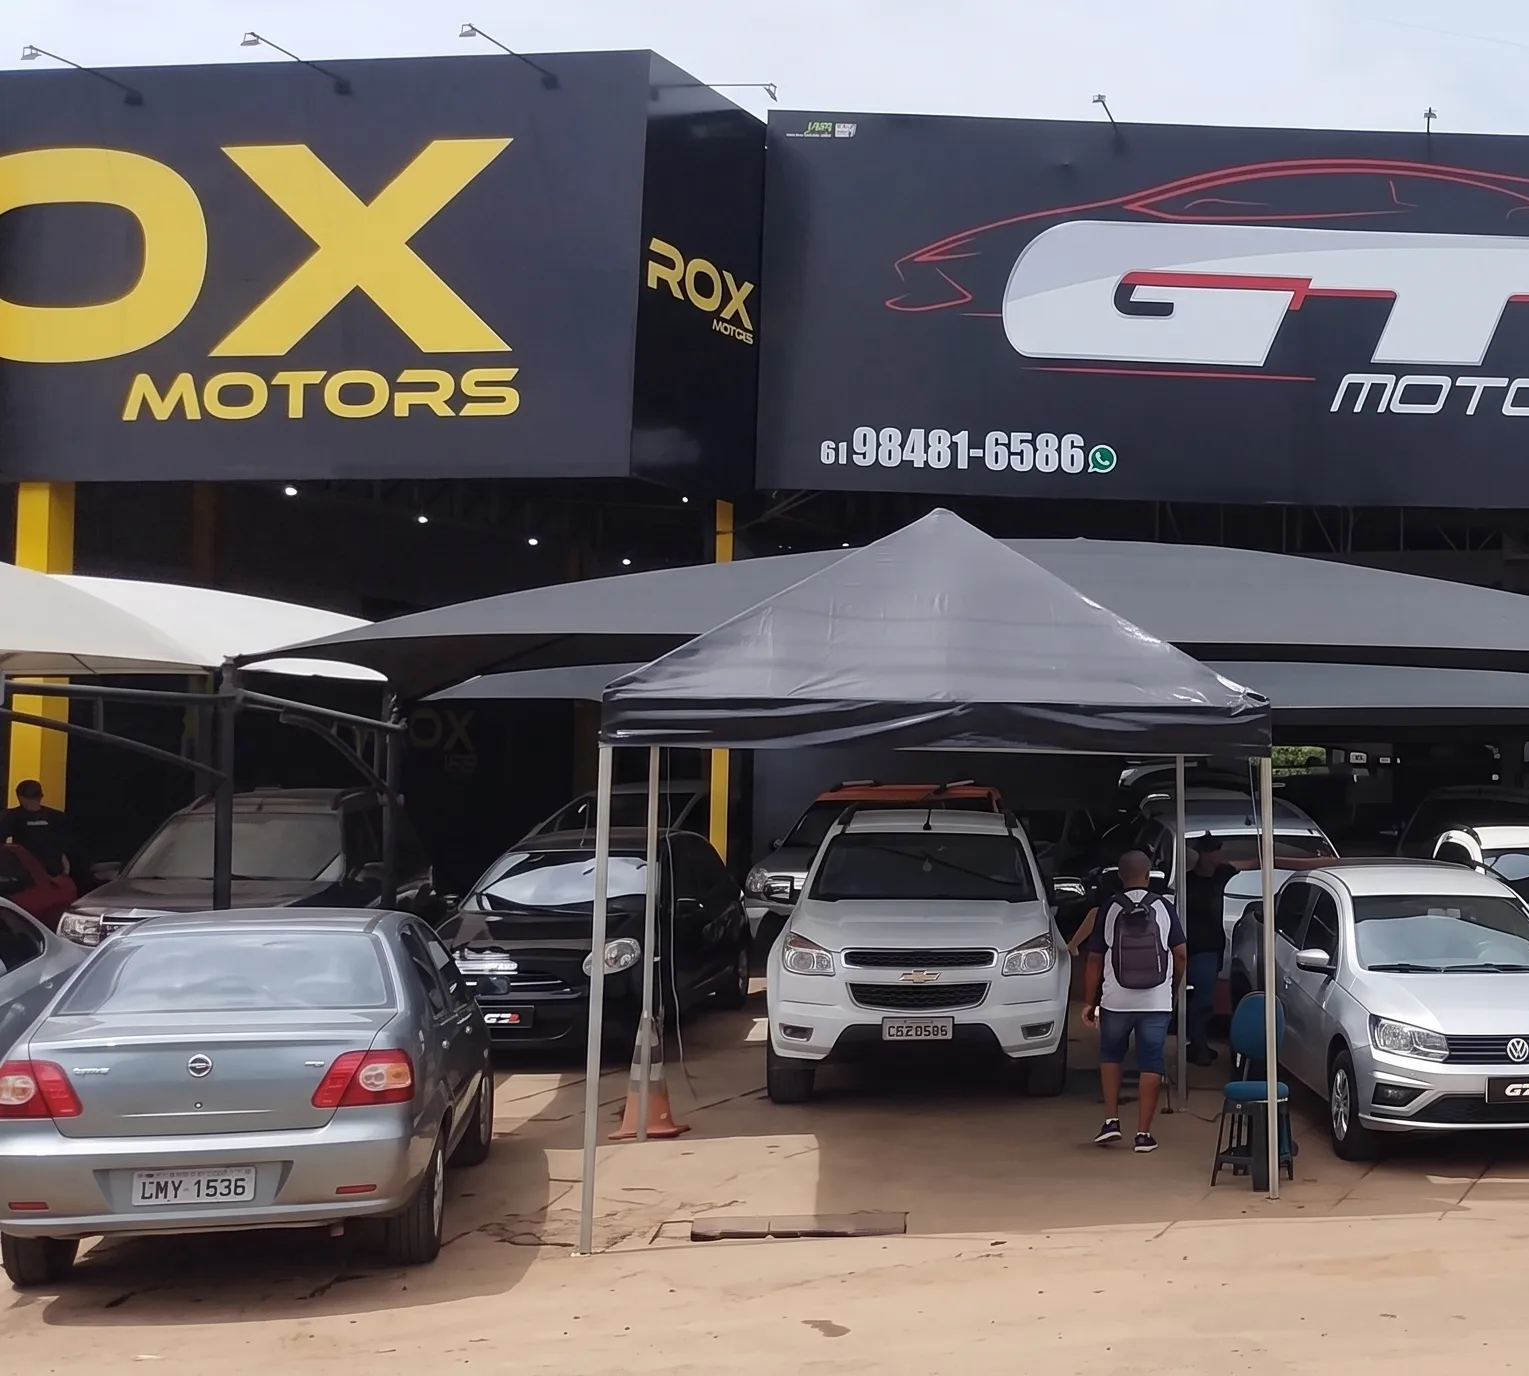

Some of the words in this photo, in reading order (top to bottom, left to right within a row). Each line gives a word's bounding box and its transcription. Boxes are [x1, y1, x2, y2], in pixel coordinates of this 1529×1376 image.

[647, 237, 755, 332] ROX
[122, 367, 521, 422] MOTORS
[819, 440, 848, 465] 61
[852, 426, 1085, 474] 98481-6586
[193, 1177, 247, 1199] 1536
